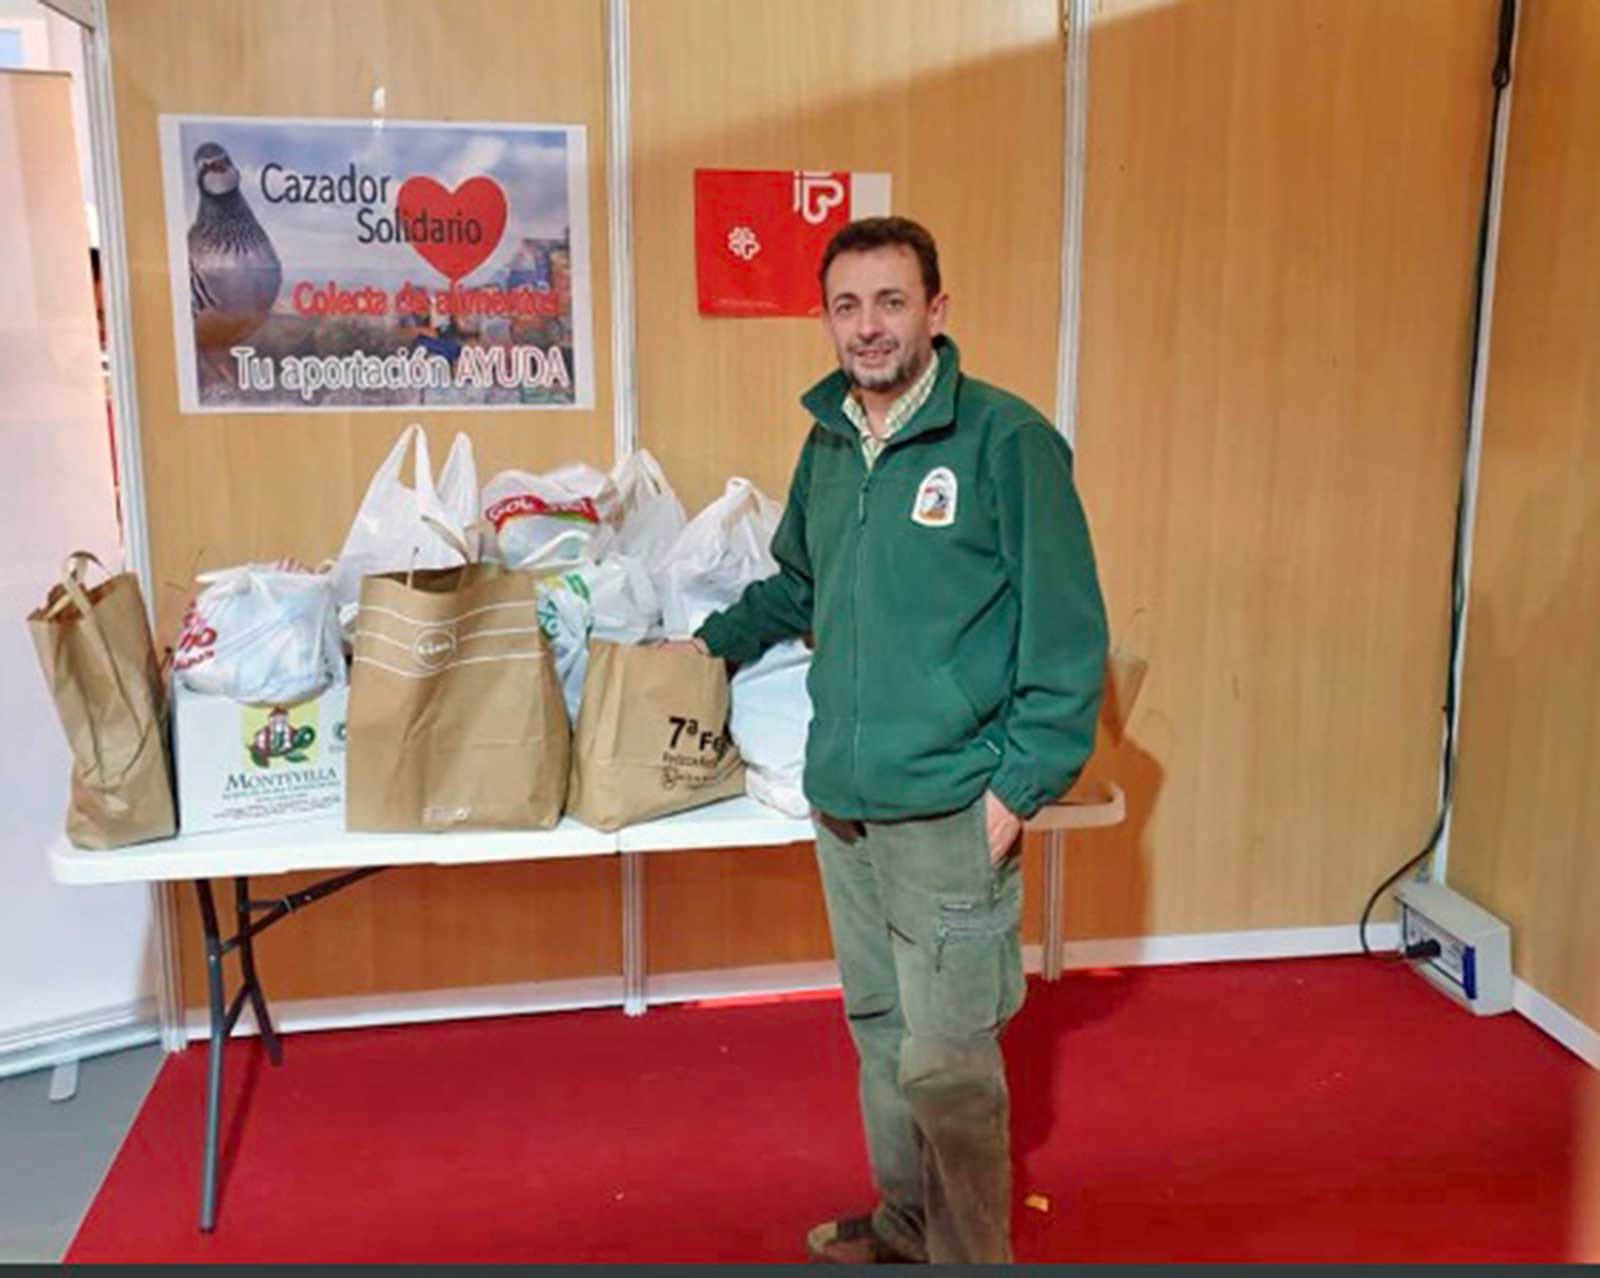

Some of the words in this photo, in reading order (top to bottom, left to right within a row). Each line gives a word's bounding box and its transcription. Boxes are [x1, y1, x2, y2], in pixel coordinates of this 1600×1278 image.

[260, 164, 390, 203] Cazador
[357, 209, 482, 245] Solidario
[293, 281, 388, 316] Colecta
[396, 281, 429, 316] de
[232, 347, 275, 390] Tu
[280, 347, 450, 399] aportación
[455, 345, 570, 388] AYUDA
